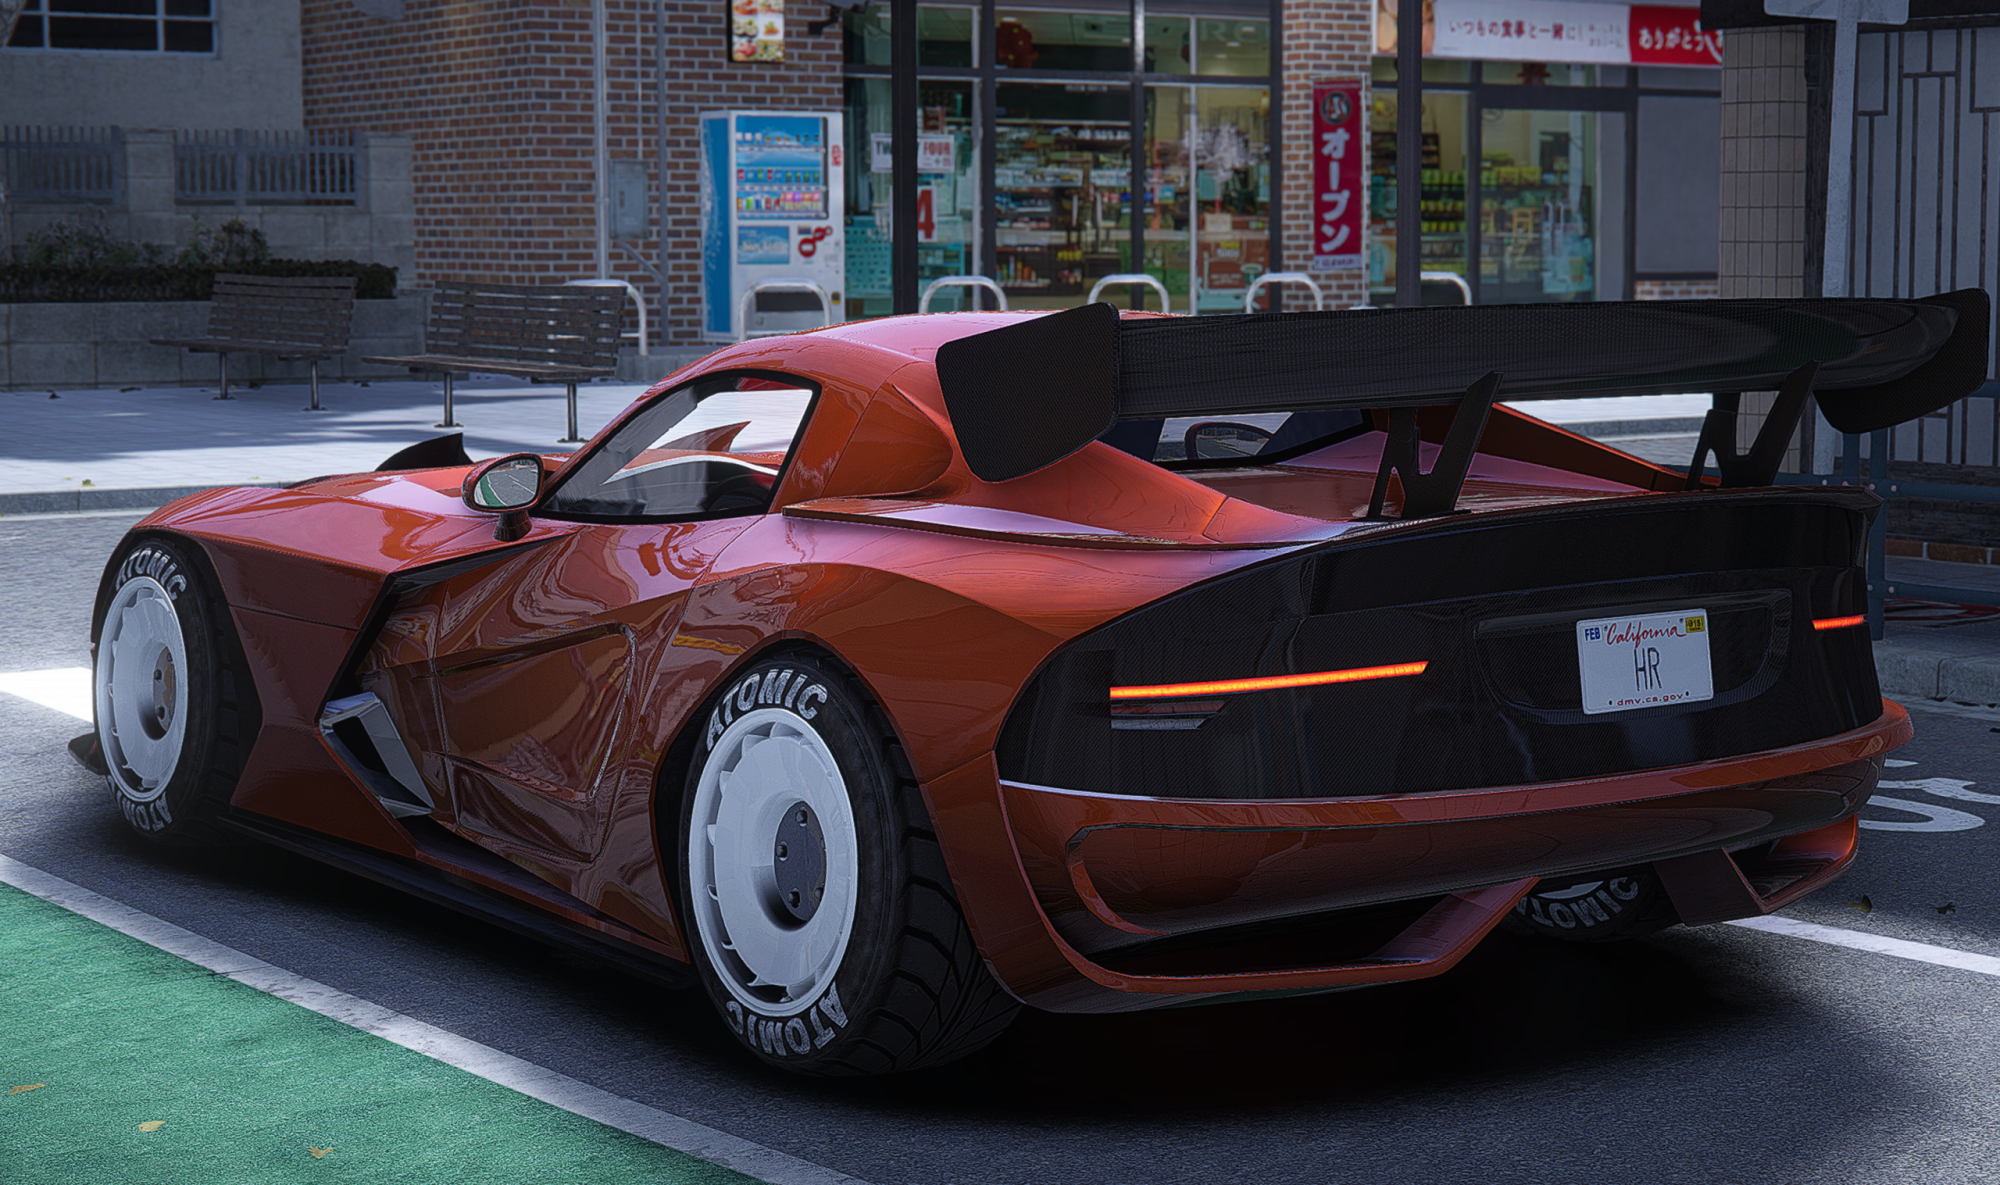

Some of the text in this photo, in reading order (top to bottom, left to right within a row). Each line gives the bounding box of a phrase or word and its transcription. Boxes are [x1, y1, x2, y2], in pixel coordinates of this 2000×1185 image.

[1638, 20, 1722, 54] ありがとう
[923, 141, 951, 156] FOUR
[917, 189, 935, 239] 4
[1320, 127, 1351, 253] オープン
[115, 547, 188, 601] ATOMIC
[1584, 626, 1601, 642] FEB
[1606, 620, 1687, 649] California
[1633, 646, 1662, 692] HR
[706, 668, 828, 752] ATOMIC
[1616, 693, 1683, 706] dmv.ca.gov
[725, 980, 849, 1057] ATOMIC
